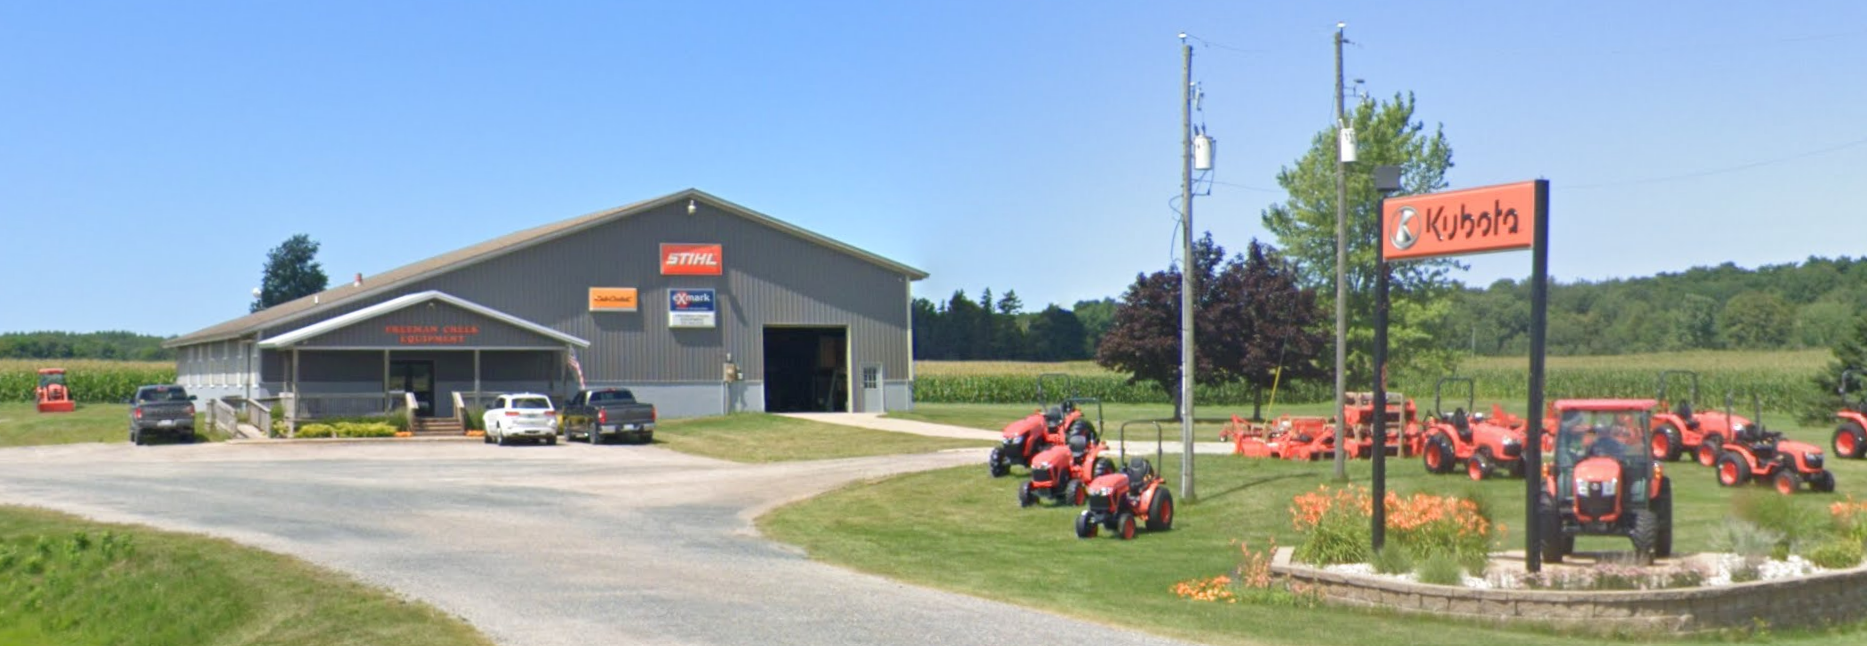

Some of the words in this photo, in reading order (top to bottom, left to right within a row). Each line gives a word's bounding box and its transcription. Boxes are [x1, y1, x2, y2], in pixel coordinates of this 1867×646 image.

[1425, 199, 1519, 242] Kubota
[666, 252, 717, 266] STIHL
[384, 325, 438, 334] FREEMAN
[399, 335, 465, 344] EQUIPMENT
